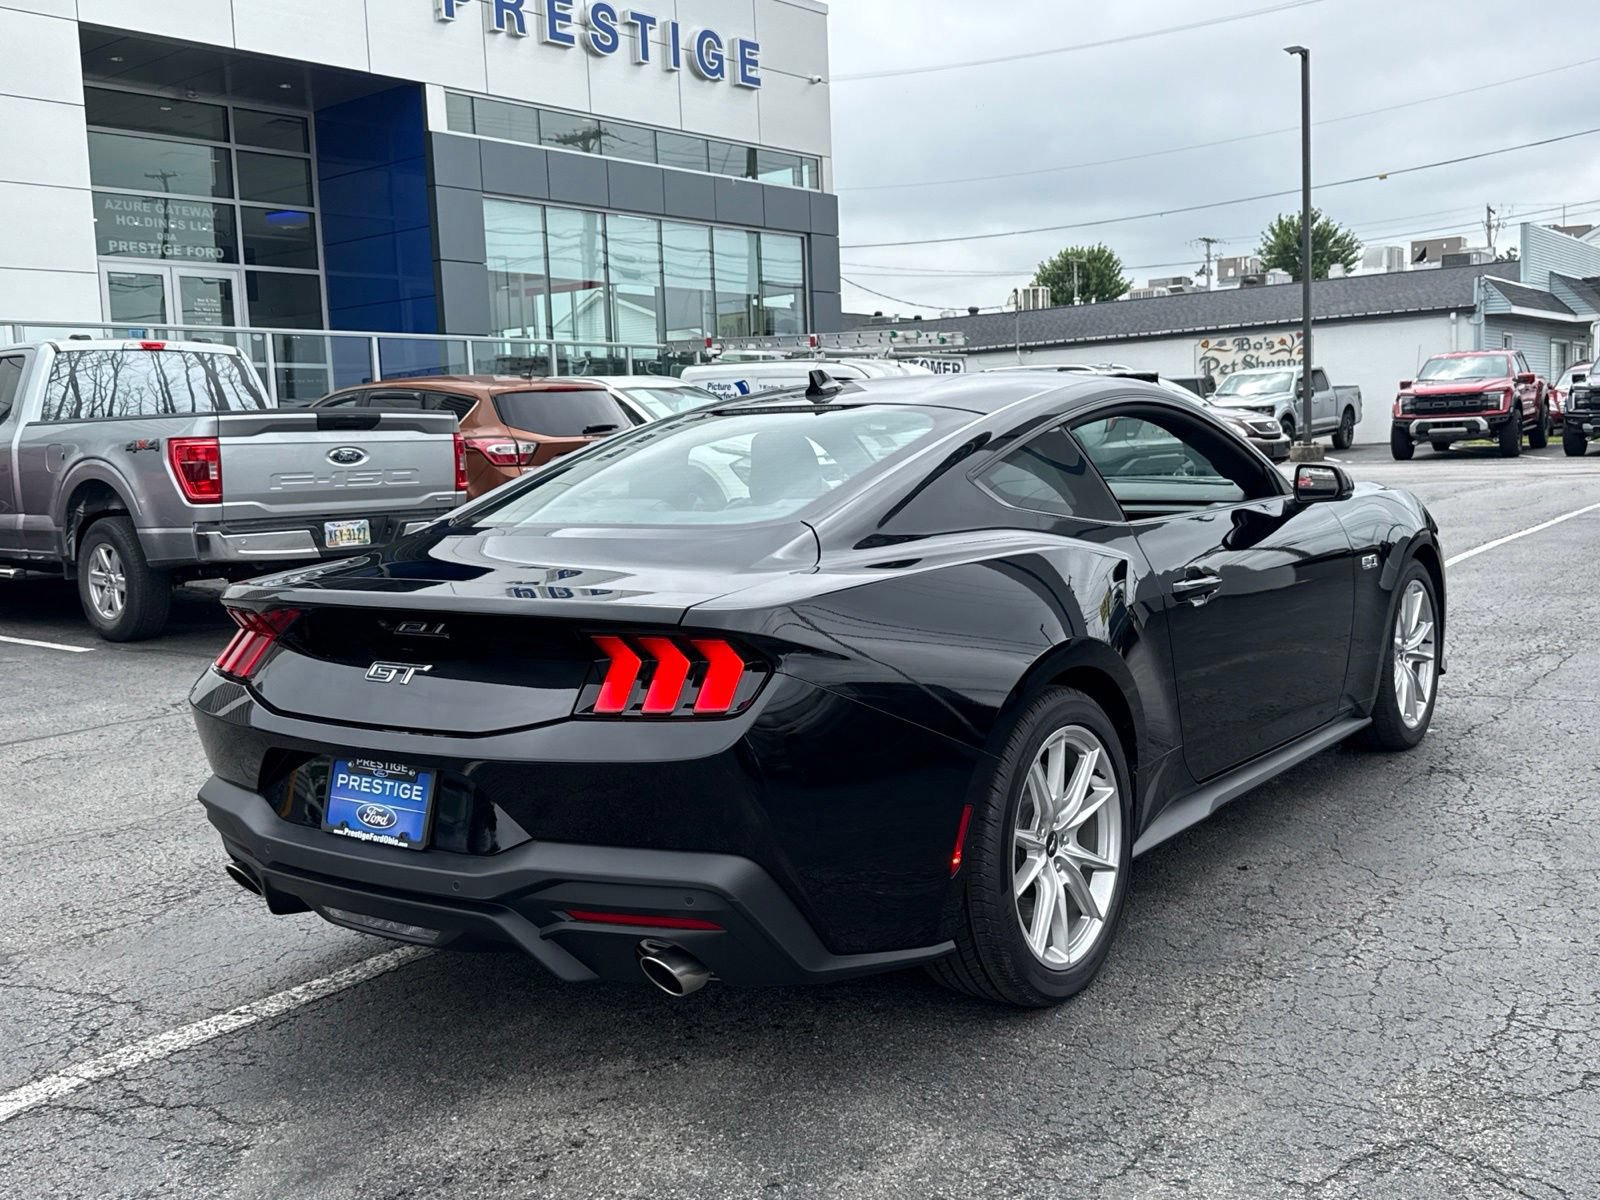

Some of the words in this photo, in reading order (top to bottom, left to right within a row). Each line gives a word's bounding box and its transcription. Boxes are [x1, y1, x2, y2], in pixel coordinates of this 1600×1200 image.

[105, 200, 152, 213] AZURE
[155, 202, 217, 218] GATEWAY
[115, 215, 186, 230] HOLDINGS
[190, 221, 214, 232] LLC
[108, 240, 184, 256] PRESTIGE
[187, 246, 225, 259] FORD
[1232, 337, 1275, 353] Bo's
[1199, 356, 1238, 375] Pet
[707, 382, 732, 391] Picture
[1416, 400, 1481, 409] FORD
[365, 661, 433, 685] GT
[336, 773, 423, 801] PRESTIGE
[363, 806, 389, 826] Ford
